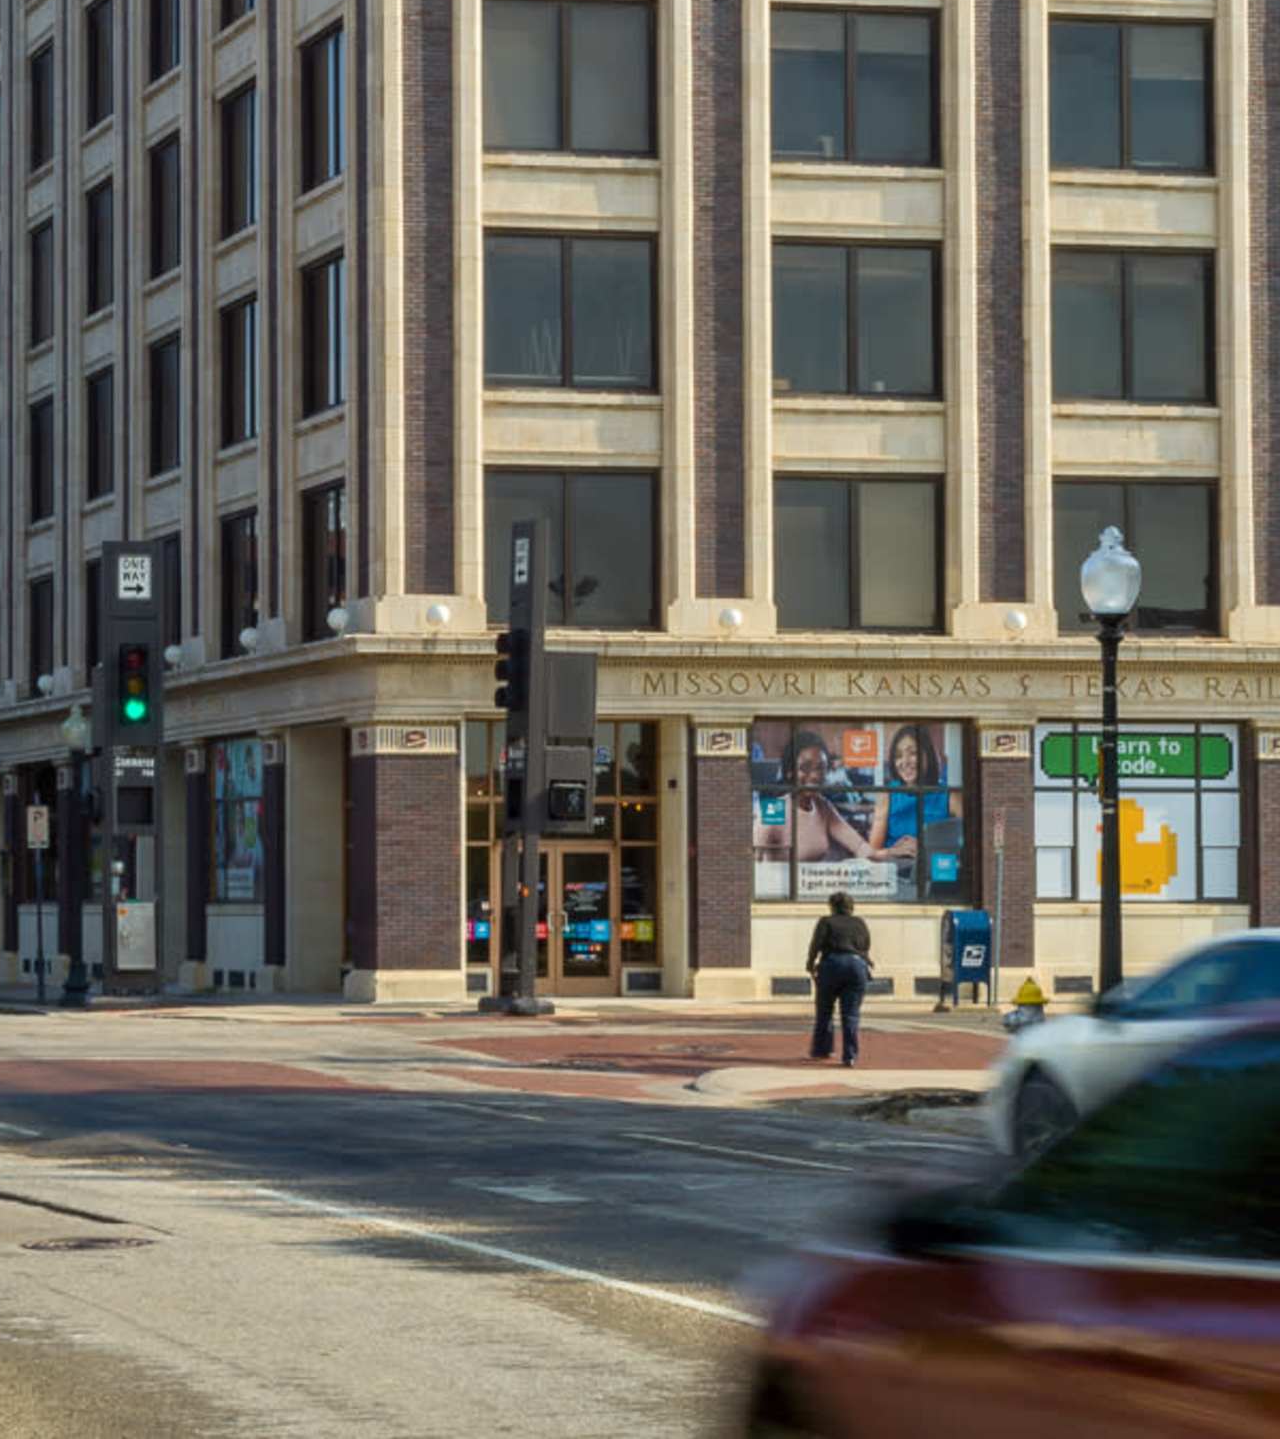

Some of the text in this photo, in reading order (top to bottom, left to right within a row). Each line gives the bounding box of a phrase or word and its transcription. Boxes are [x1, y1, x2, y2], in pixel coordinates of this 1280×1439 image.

[123, 559, 145, 570] ONE
[123, 572, 145, 582] WAY
[643, 672, 817, 697] MISSOVRI
[847, 672, 992, 697] KANSAS
[1091, 736, 1181, 755] Larn to
[1117, 756, 1166, 775] ode.
